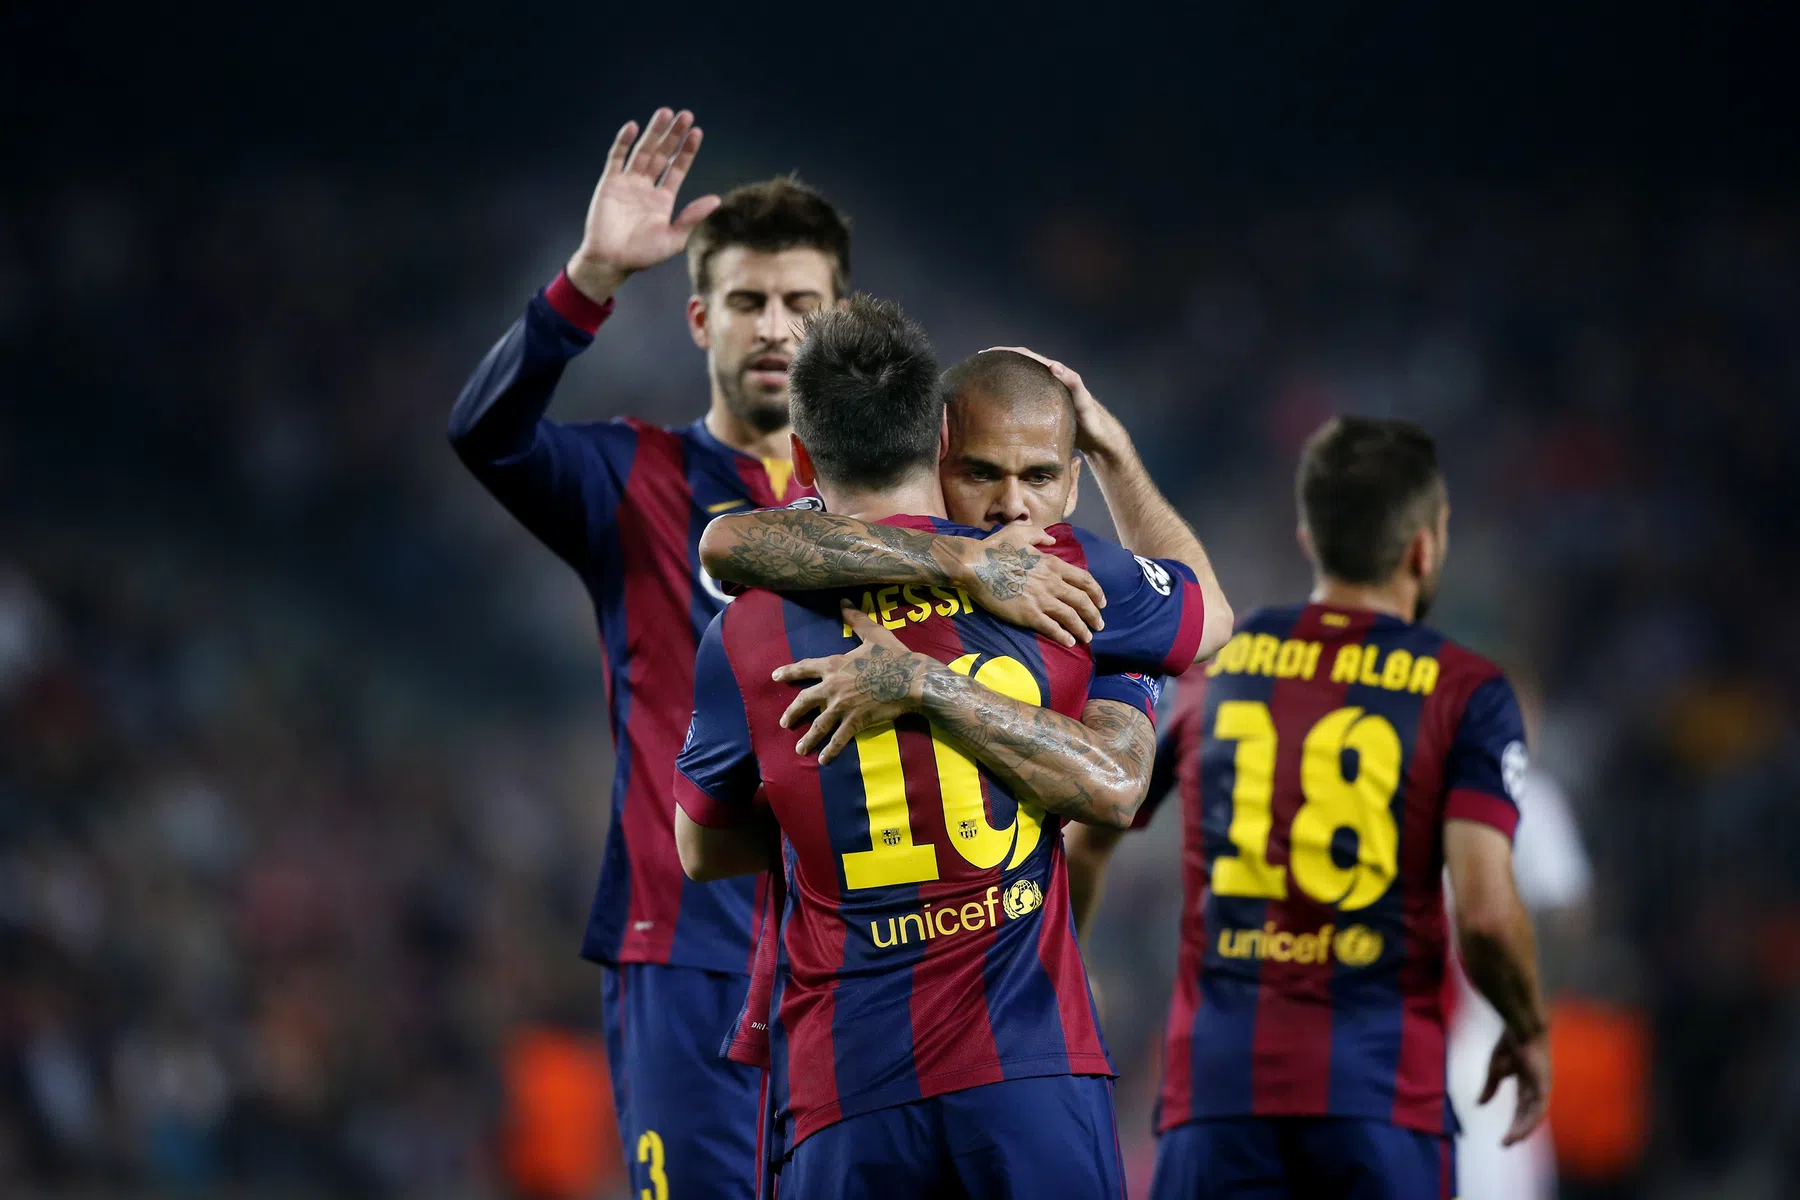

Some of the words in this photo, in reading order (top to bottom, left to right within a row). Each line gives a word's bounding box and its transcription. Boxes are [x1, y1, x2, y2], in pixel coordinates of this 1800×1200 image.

[1205, 632, 1322, 681] JORDI
[1330, 643, 1440, 695] ALBA
[820, 652, 1047, 890] 10
[1211, 700, 1402, 912] 18
[870, 886, 999, 948] unicef
[1217, 920, 1336, 965] unicef
[637, 1129, 669, 1200] 3
